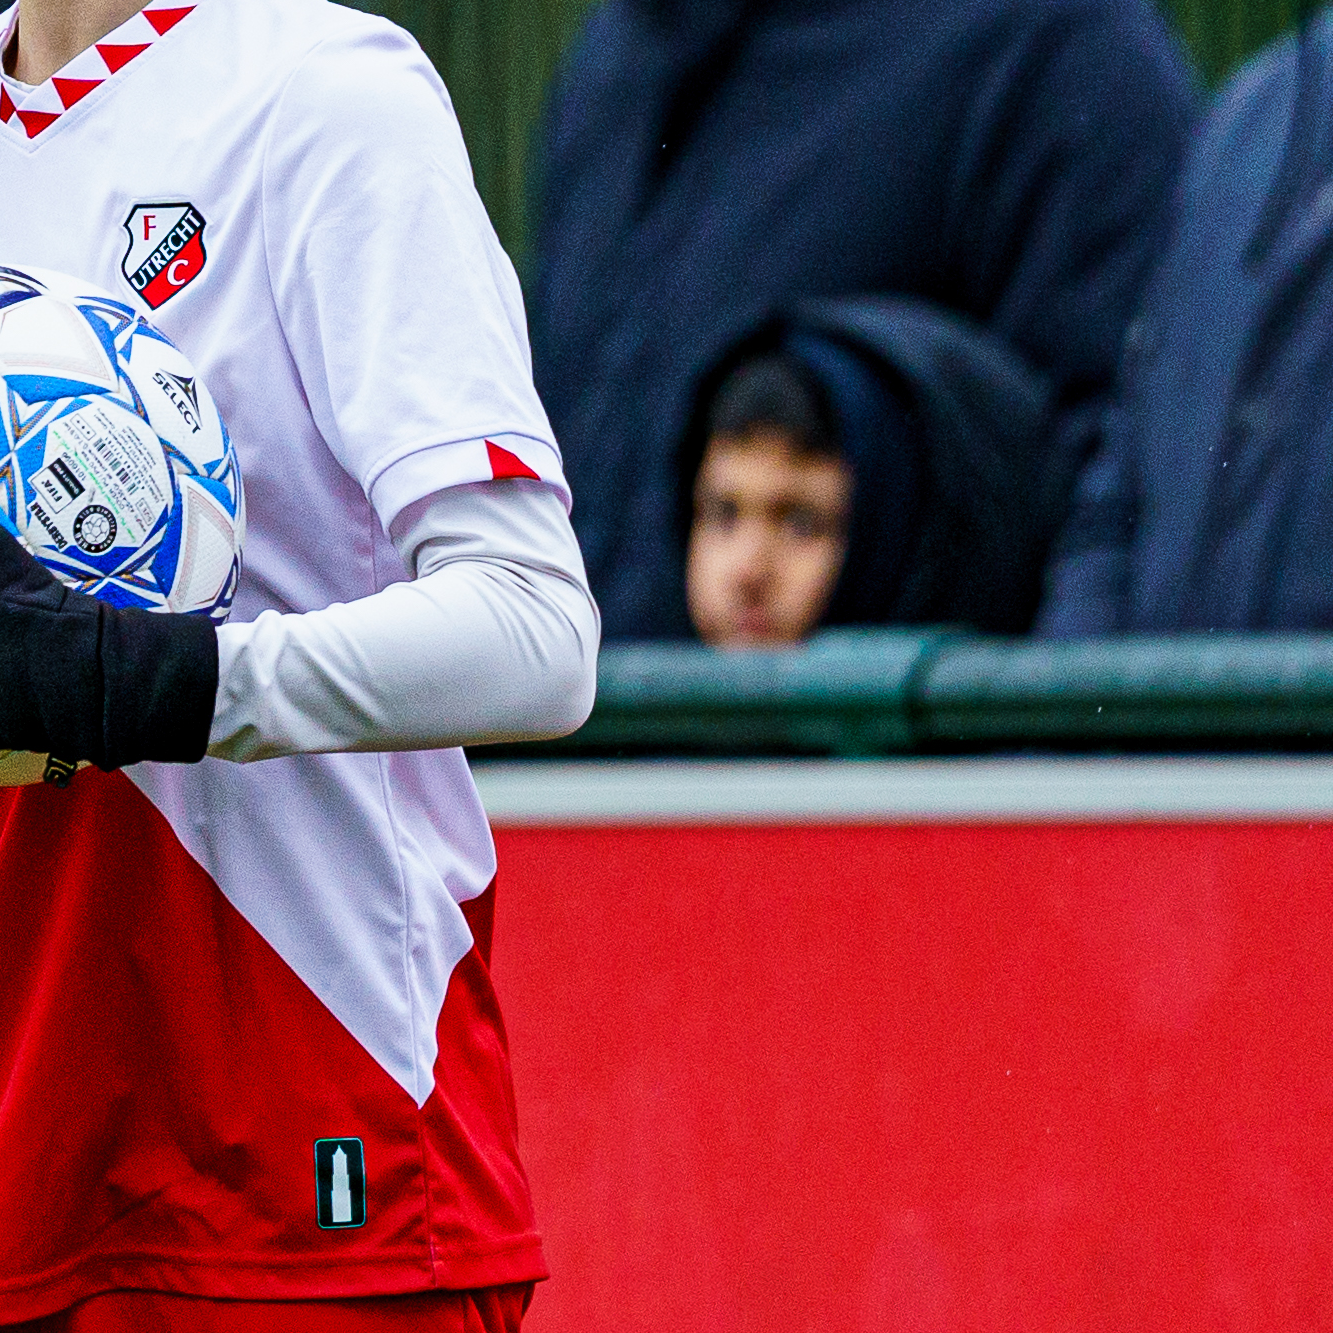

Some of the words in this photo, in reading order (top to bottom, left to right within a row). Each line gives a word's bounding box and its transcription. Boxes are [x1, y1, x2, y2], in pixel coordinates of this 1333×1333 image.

[143, 215, 157, 241] F
[130, 209, 201, 291] UTRECHT
[166, 258, 189, 286] C
[152, 372, 201, 434] SELECT
[41, 478, 63, 503] FIFA
[30, 501, 68, 549] DERBYSTAR
